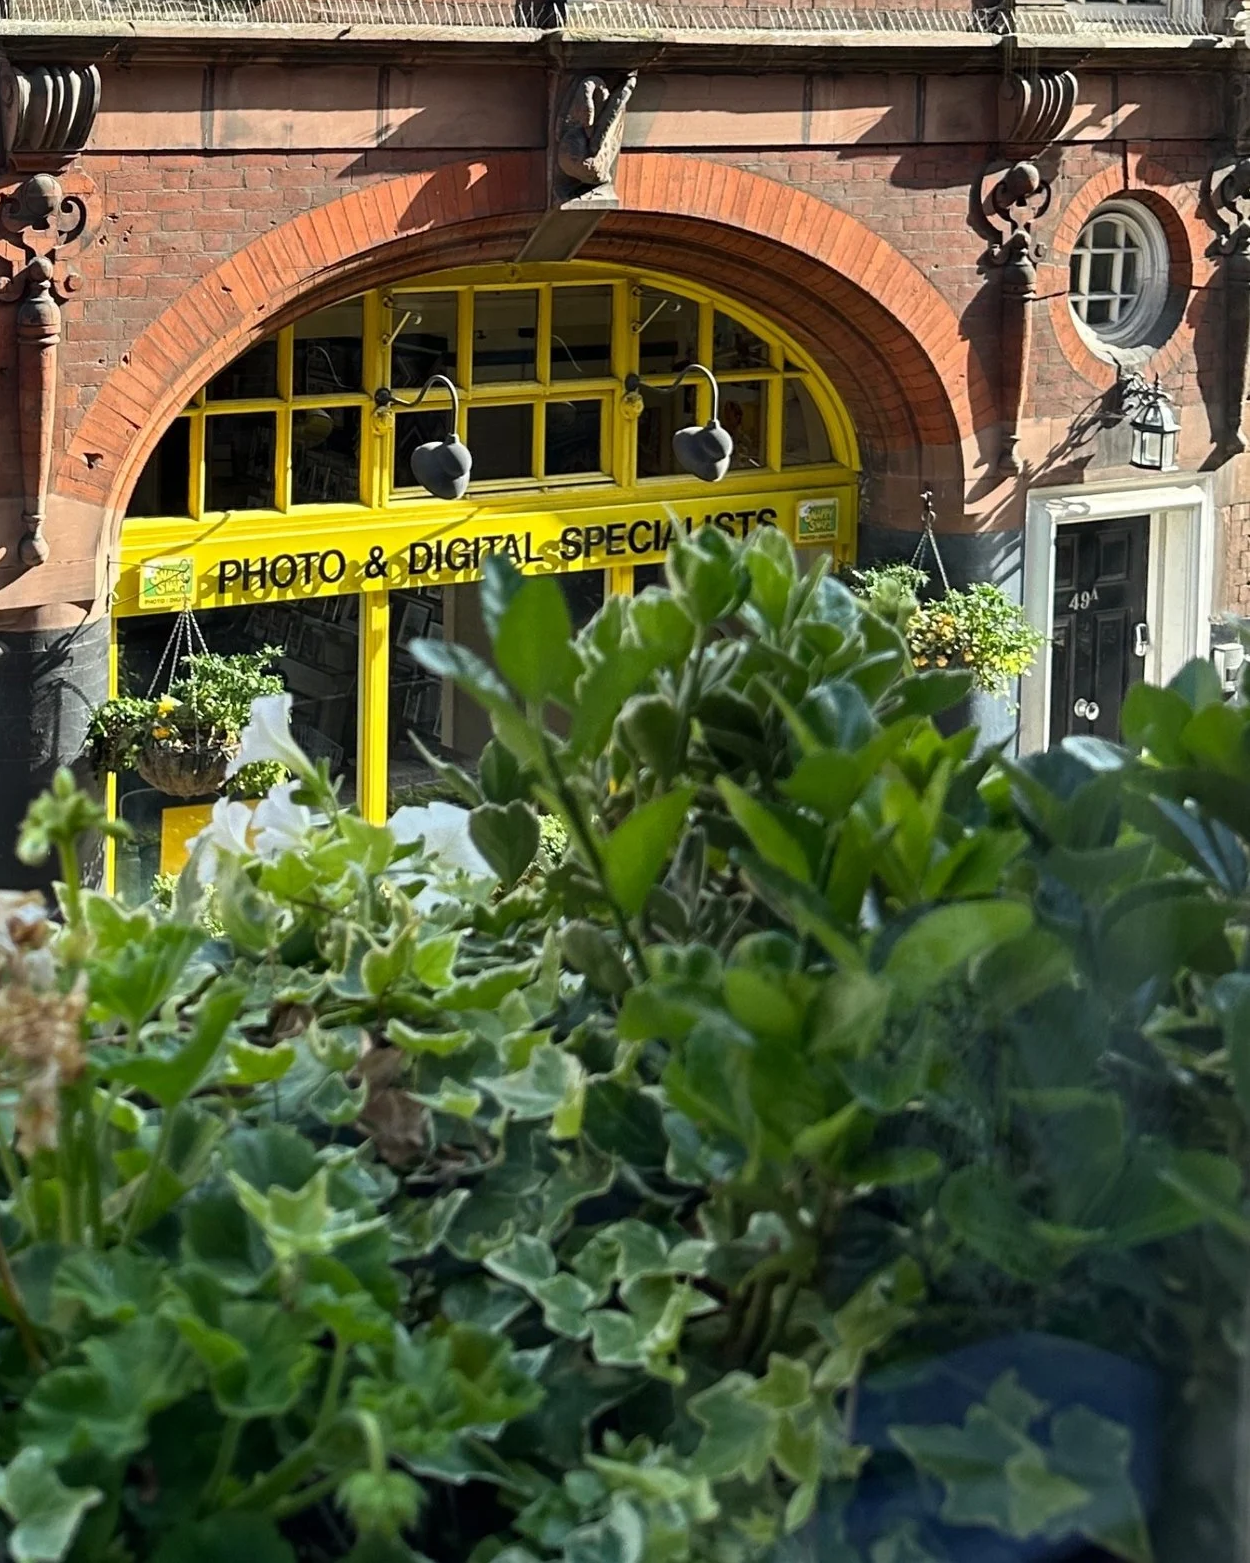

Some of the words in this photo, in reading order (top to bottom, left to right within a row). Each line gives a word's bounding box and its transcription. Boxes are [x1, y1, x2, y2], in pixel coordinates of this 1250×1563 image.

[218, 548, 346, 593] PHOTO
[365, 545, 388, 579] &
[408, 532, 543, 575] DIGITAL
